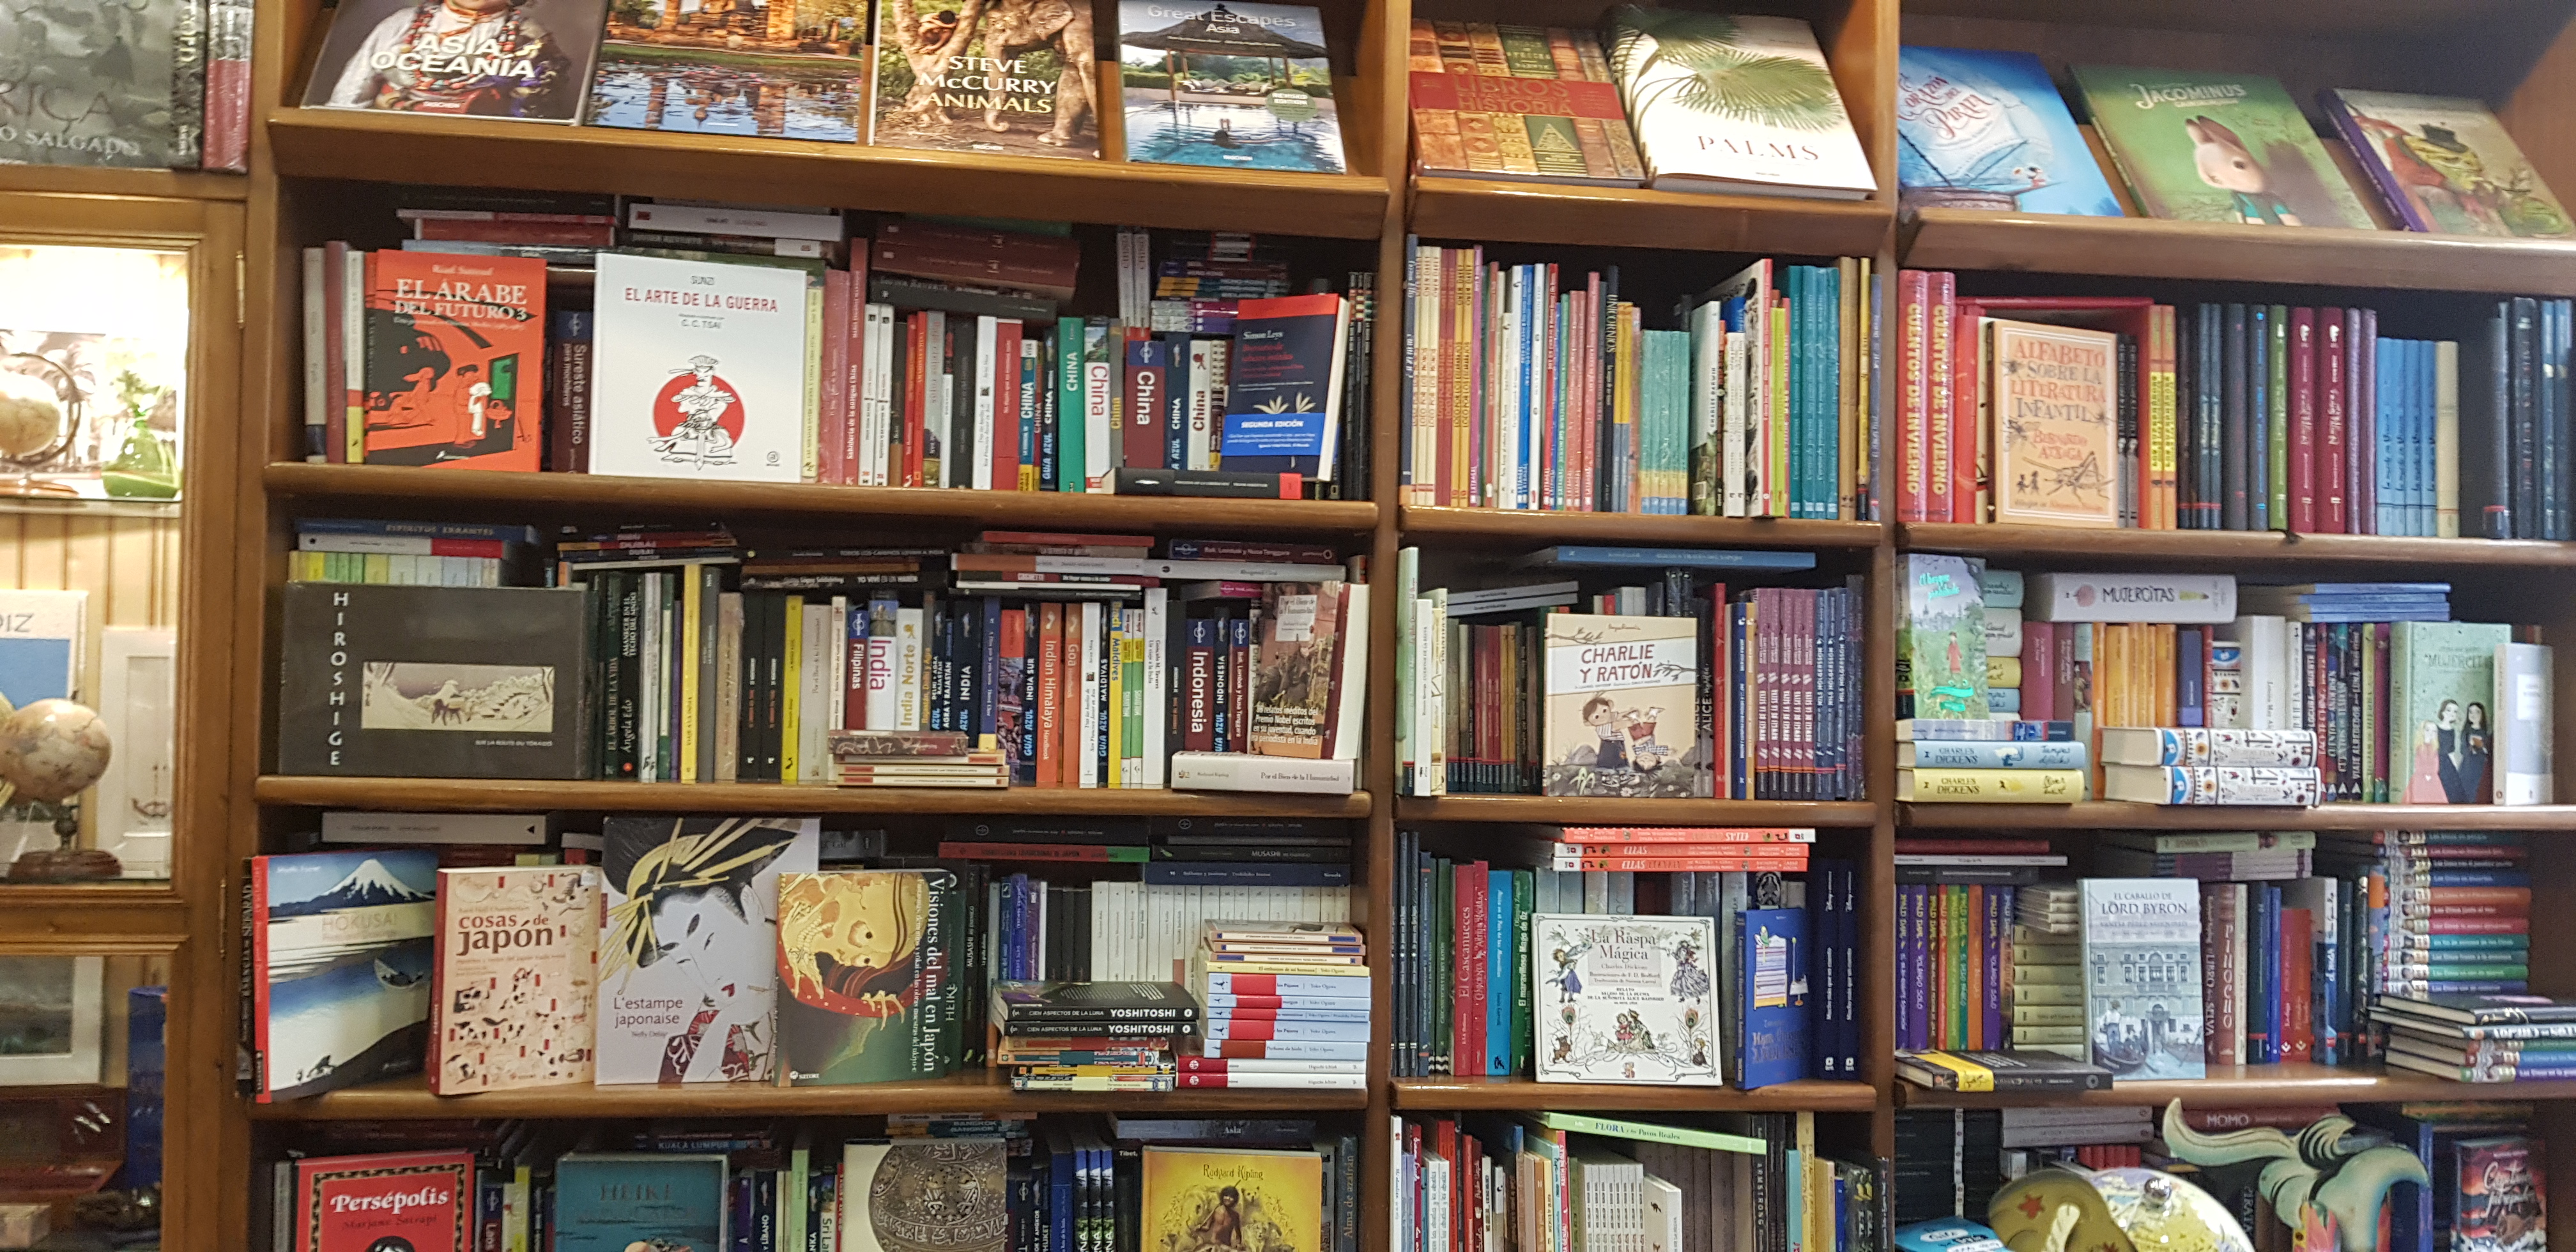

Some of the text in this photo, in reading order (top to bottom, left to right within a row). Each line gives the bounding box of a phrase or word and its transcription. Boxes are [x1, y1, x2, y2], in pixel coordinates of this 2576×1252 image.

[1147, 5, 1296, 27] Great Escapes
[1205, 23, 1240, 34] Asia
[415, 34, 500, 56] ASIA
[948, 55, 1028, 75] STEVE
[919, 72, 1057, 95] McCURRY
[1452, 74, 1570, 97] LIBROS
[926, 92, 1053, 114] ANIMALS
[1457, 96, 1576, 117] HISTORIA
[2128, 83, 2248, 110] JACOMINUS
[1697, 135, 1819, 160] PALMS
[396, 277, 527, 305] EL ÁRABE
[625, 287, 778, 313] EL ARTE DE LA GUERRA
[394, 301, 528, 322] DEL FUTURO 3
[1606, 294, 1618, 353] UNICORNIOS
[2015, 338, 2106, 367] ALFABETO
[573, 344, 586, 393] Sureste
[850, 365, 858, 383] China
[1066, 352, 1078, 391] CHINA
[2027, 360, 2101, 384] SOBRE LA
[1020, 382, 1035, 419] CHINA
[1091, 365, 1109, 416] China
[1137, 371, 1156, 425] China
[1906, 303, 1921, 494] CUENTOS DE INVIERNO
[1932, 305, 1947, 495] CUENTOS DE INVIERNO
[2012, 379, 2106, 402] LITERATURA
[1034, 402, 1043, 434] CHINA
[1110, 397, 1121, 429] China
[1193, 390, 1206, 431] China
[2016, 397, 2095, 423] INFANTIL
[1044, 391, 1054, 455] AZUL CHINA
[1171, 397, 1181, 460] AZUL CHINA
[2103, 586, 2175, 604] MUJERCITAS
[870, 639, 892, 691] India
[1045, 640, 1057, 675] Indian
[1068, 644, 1078, 666] Goa
[1581, 644, 1655, 664] CHARLIE
[852, 643, 866, 691] Filipinas
[1579, 660, 1653, 683] Y RATÓN
[328, 592, 349, 767] HIROSHIGE
[900, 645, 916, 727] India Norte
[608, 657, 618, 751] EL VIDA
[943, 661, 952, 728] AGRA RAJASTÁN
[960, 665, 971, 731] AZUL INDIA
[1040, 677, 1057, 729] Himalaya
[1191, 652, 1209, 734] Indonesia
[1216, 655, 1227, 735] AZUL INDONESIA
[931, 708, 941, 730] AZUL
[1023, 658, 1035, 756] GUÍA AZUL INDIA SUR
[1702, 698, 1713, 731] ALICE
[620, 699, 634, 753] Ángela Edo
[1099, 735, 1107, 757] GUÍA
[1935, 754, 1978, 765] DICKENS
[1936, 785, 1980, 795] DICKENS
[1623, 846, 1648, 855] ELLAS
[1621, 860, 1646, 869] ELLAS
[2113, 892, 2160, 900] EL CABALLO
[2101, 903, 2188, 915] LORD BYRON
[321, 915, 395, 933] HOKUSAI
[459, 914, 549, 929] cosas de
[456, 920, 553, 956] japón
[1519, 933, 1528, 953] Mago
[1591, 929, 1657, 949] La Raspa
[1459, 906, 1471, 998] El Cascanueces
[1600, 944, 1648, 963] Mágica
[923, 878, 946, 1073] Visiones del mal en Japón
[1519, 954, 1528, 998] maravilloso
[2223, 924, 2234, 1029] PINOCHO
[613, 998, 683, 1013] L'estampe
[1110, 1009, 1176, 1018] YOSHITOSHI
[615, 1014, 680, 1029] japonaise
[1108, 1025, 1174, 1034] YOSHITOSHI
[2205, 1001, 2214, 1037] SELVA
[1223, 1126, 1241, 1134] Asia
[1594, 1122, 1625, 1134] FLORA
[2207, 1113, 2250, 1127] MOMO
[1203, 1164, 1263, 1181] Rudyard Kipling
[330, 1187, 449, 1215] Persépolis
[1346, 1200, 1354, 1212] de
[342, 1214, 438, 1231] Marjane Satrapi
[822, 1217, 832, 1233] Sri
[1342, 1216, 1354, 1239] Alma
